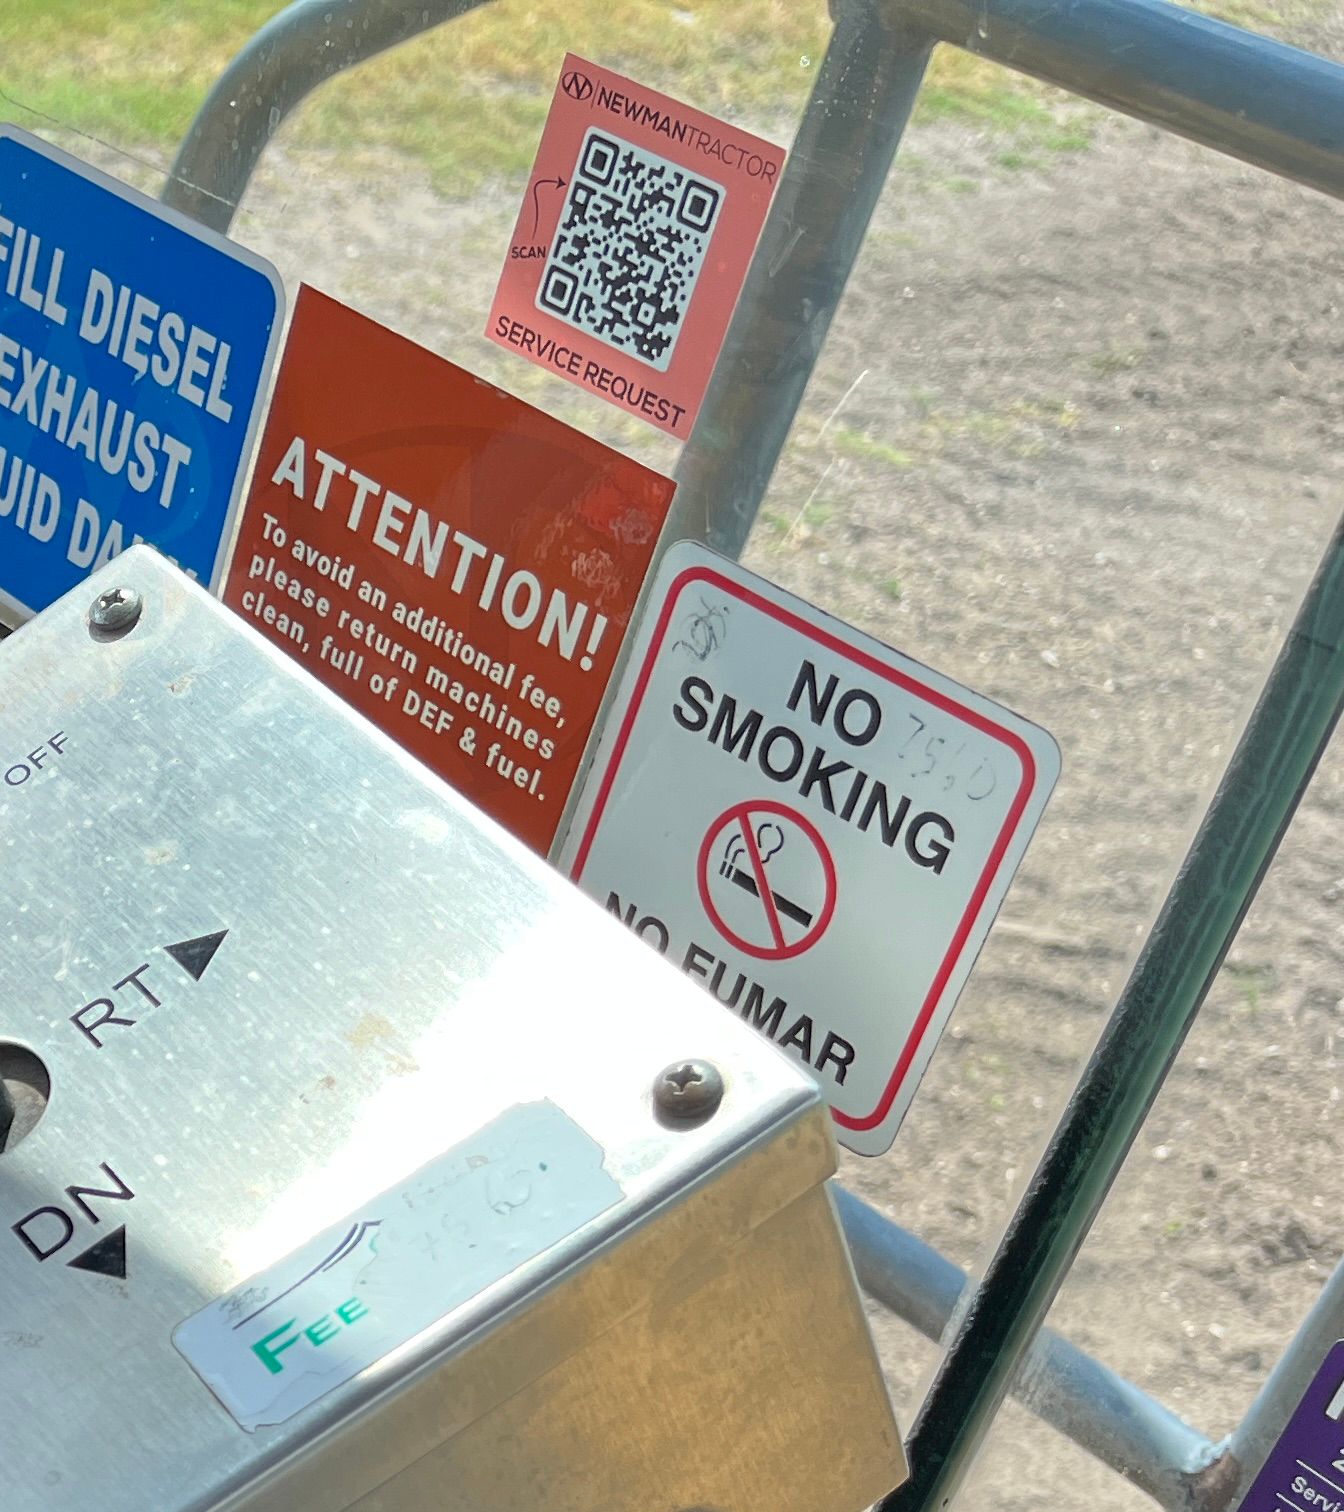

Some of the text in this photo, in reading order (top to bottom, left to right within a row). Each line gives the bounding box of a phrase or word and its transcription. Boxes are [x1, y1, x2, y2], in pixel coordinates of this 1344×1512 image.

[597, 87, 776, 183] NEWMANTRACTOR
[512, 245, 547, 260] SCAN
[79, 268, 233, 425] DIESEL
[495, 315, 686, 429] SERVICE REQUEST
[271, 436, 608, 673] ATTENTION!
[248, 553, 556, 760] please return machines
[263, 513, 566, 728] To avoid an additional fee,
[4, 732, 69, 787] OFF
[241, 590, 545, 802] clean, full of DEF & fuel.
[785, 659, 882, 747] NO
[672, 675, 956, 876] SMOKING
[70, 964, 162, 1048] RT
[681, 942, 855, 1086] FUMAR
[11, 1162, 136, 1262] DN
